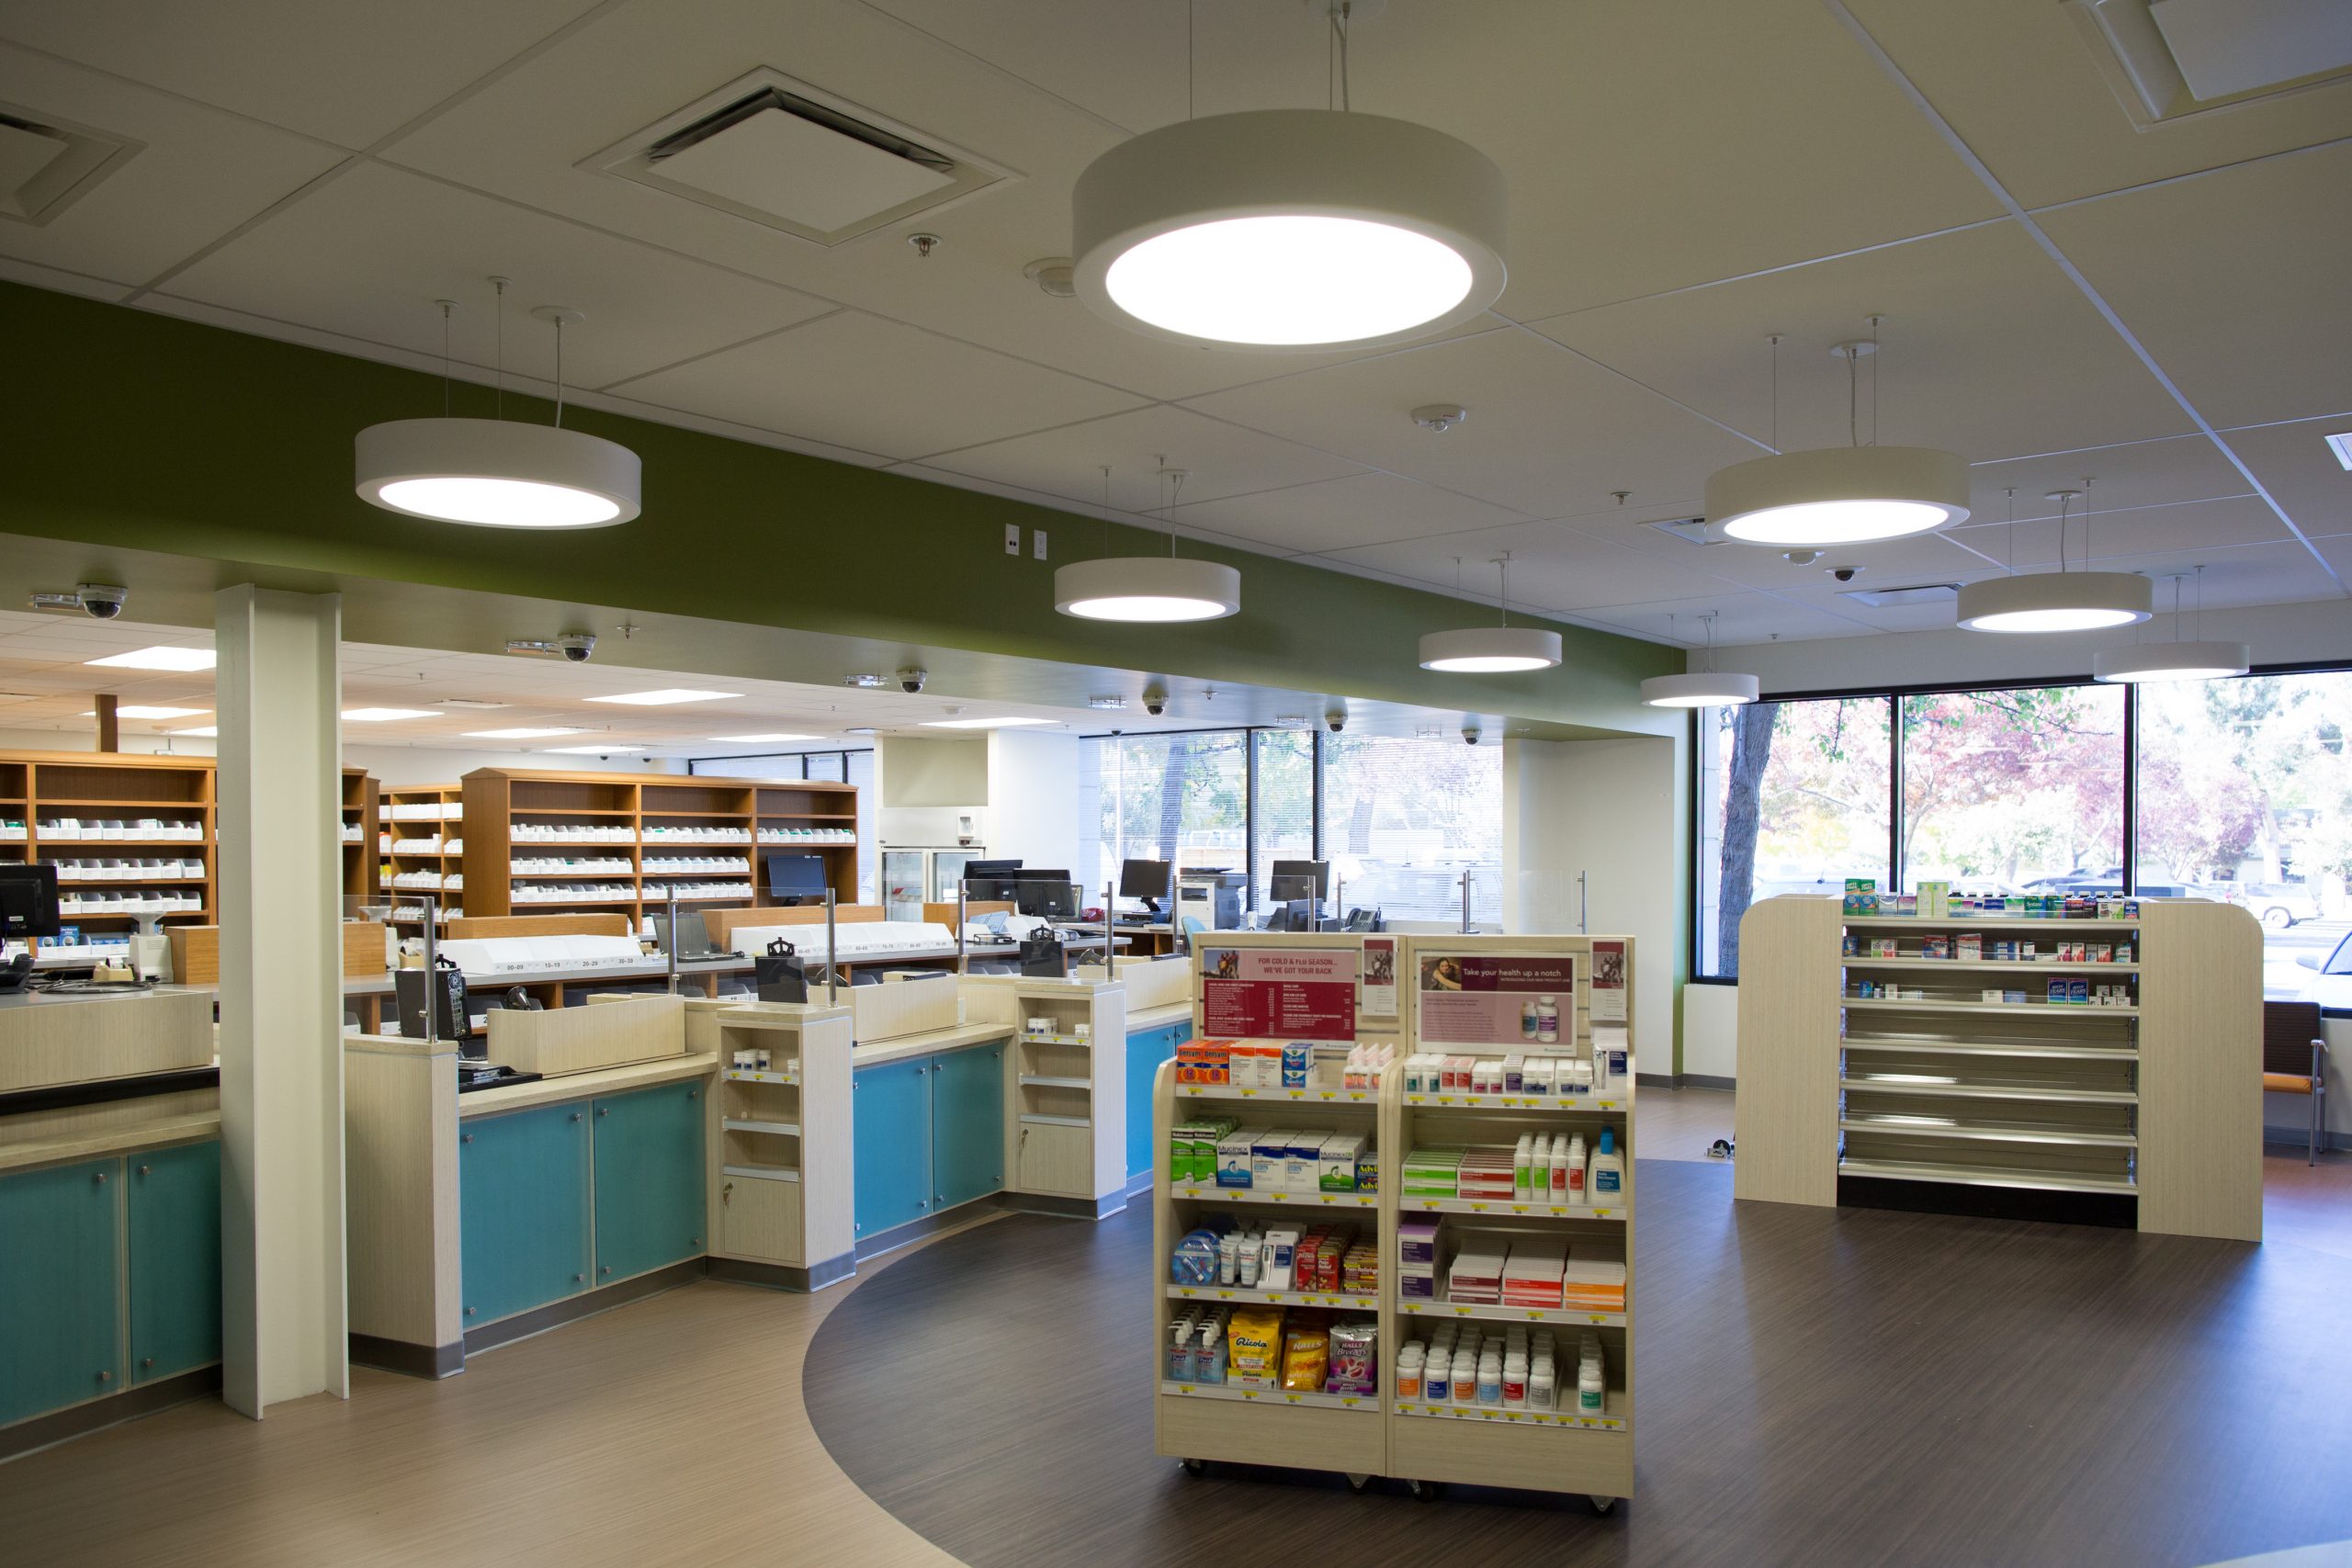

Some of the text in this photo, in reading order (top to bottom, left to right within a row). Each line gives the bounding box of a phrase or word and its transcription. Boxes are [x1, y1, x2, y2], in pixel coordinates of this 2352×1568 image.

[1179, 1049, 1201, 1057] Delsym
[1204, 1050, 1227, 1058] Delsym
[1236, 1337, 1267, 1348] Ricola
[1294, 1341, 1323, 1349] HALLS
